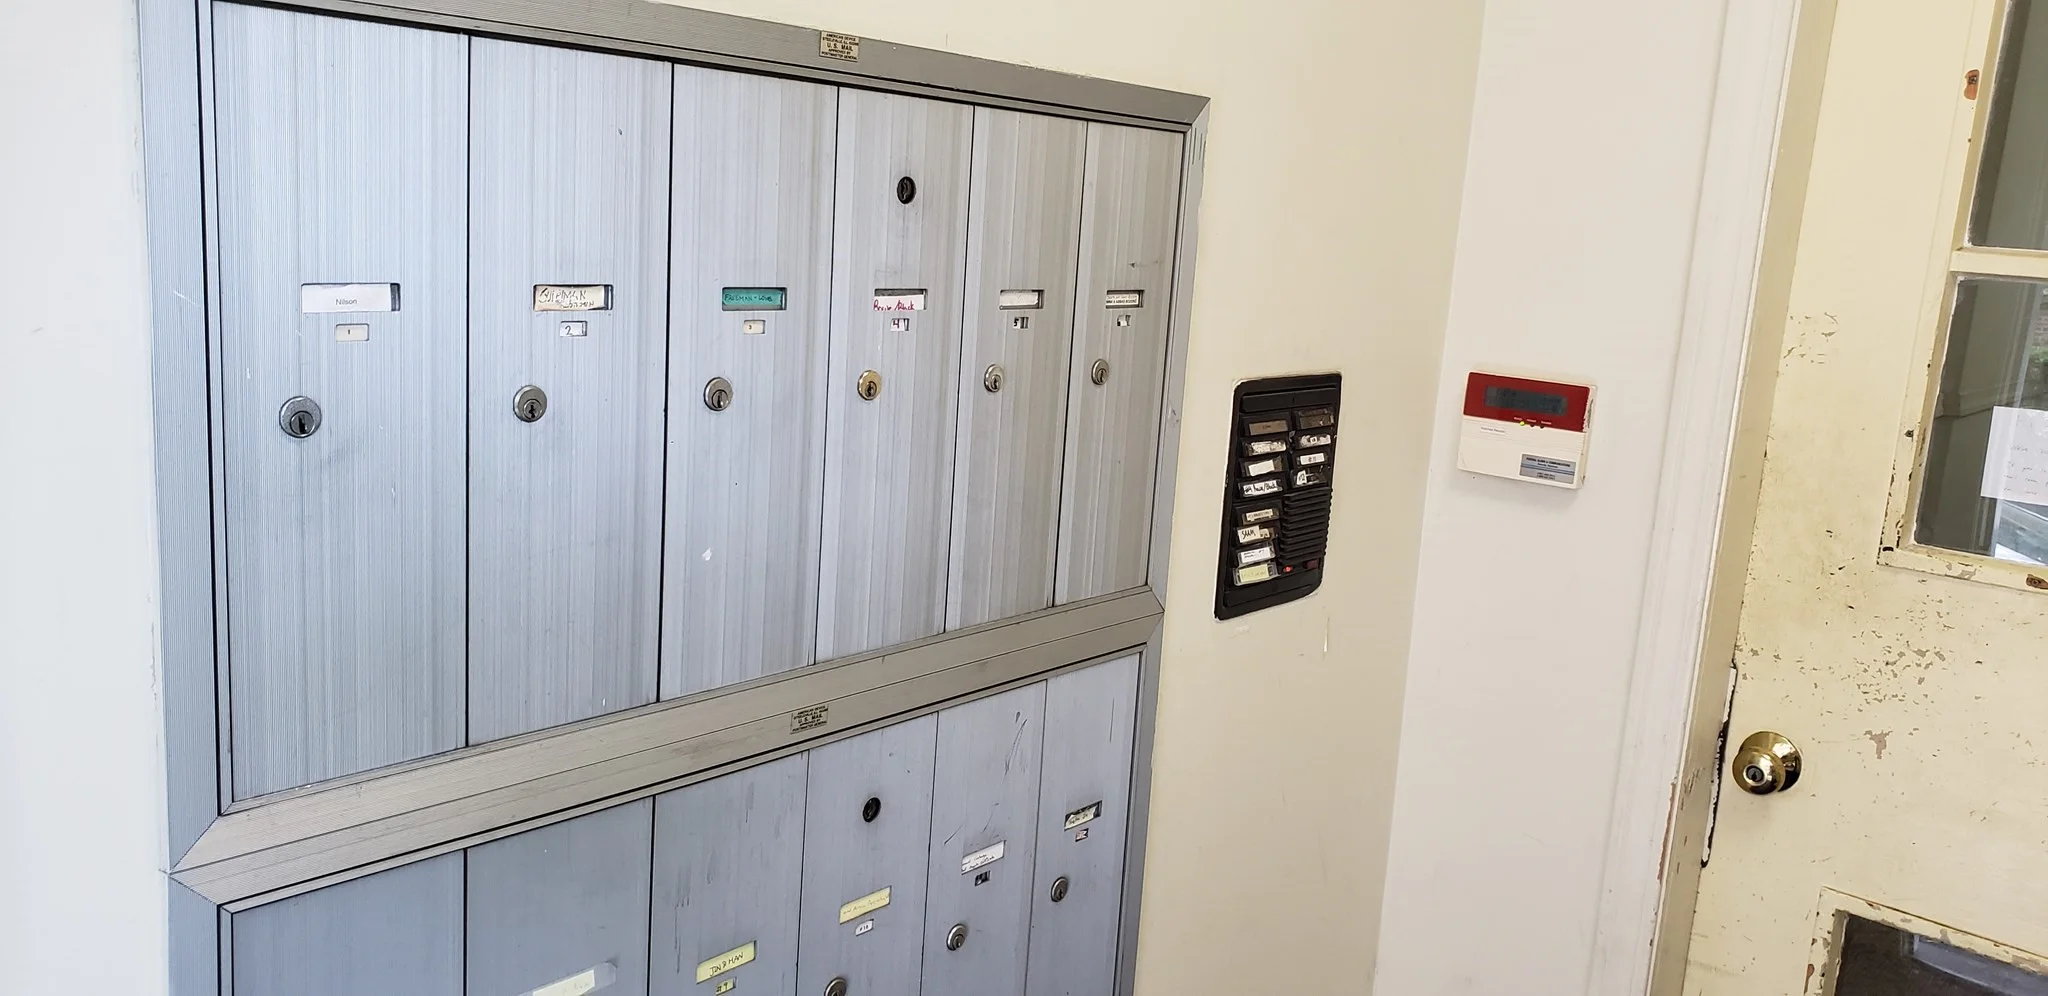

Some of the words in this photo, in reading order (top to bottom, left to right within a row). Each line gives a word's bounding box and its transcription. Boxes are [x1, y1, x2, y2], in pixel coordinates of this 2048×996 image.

[841, 44, 853, 52] MAIL
[892, 319, 900, 329] 4
[1013, 318, 1020, 327] 5
[564, 325, 573, 336] 2
